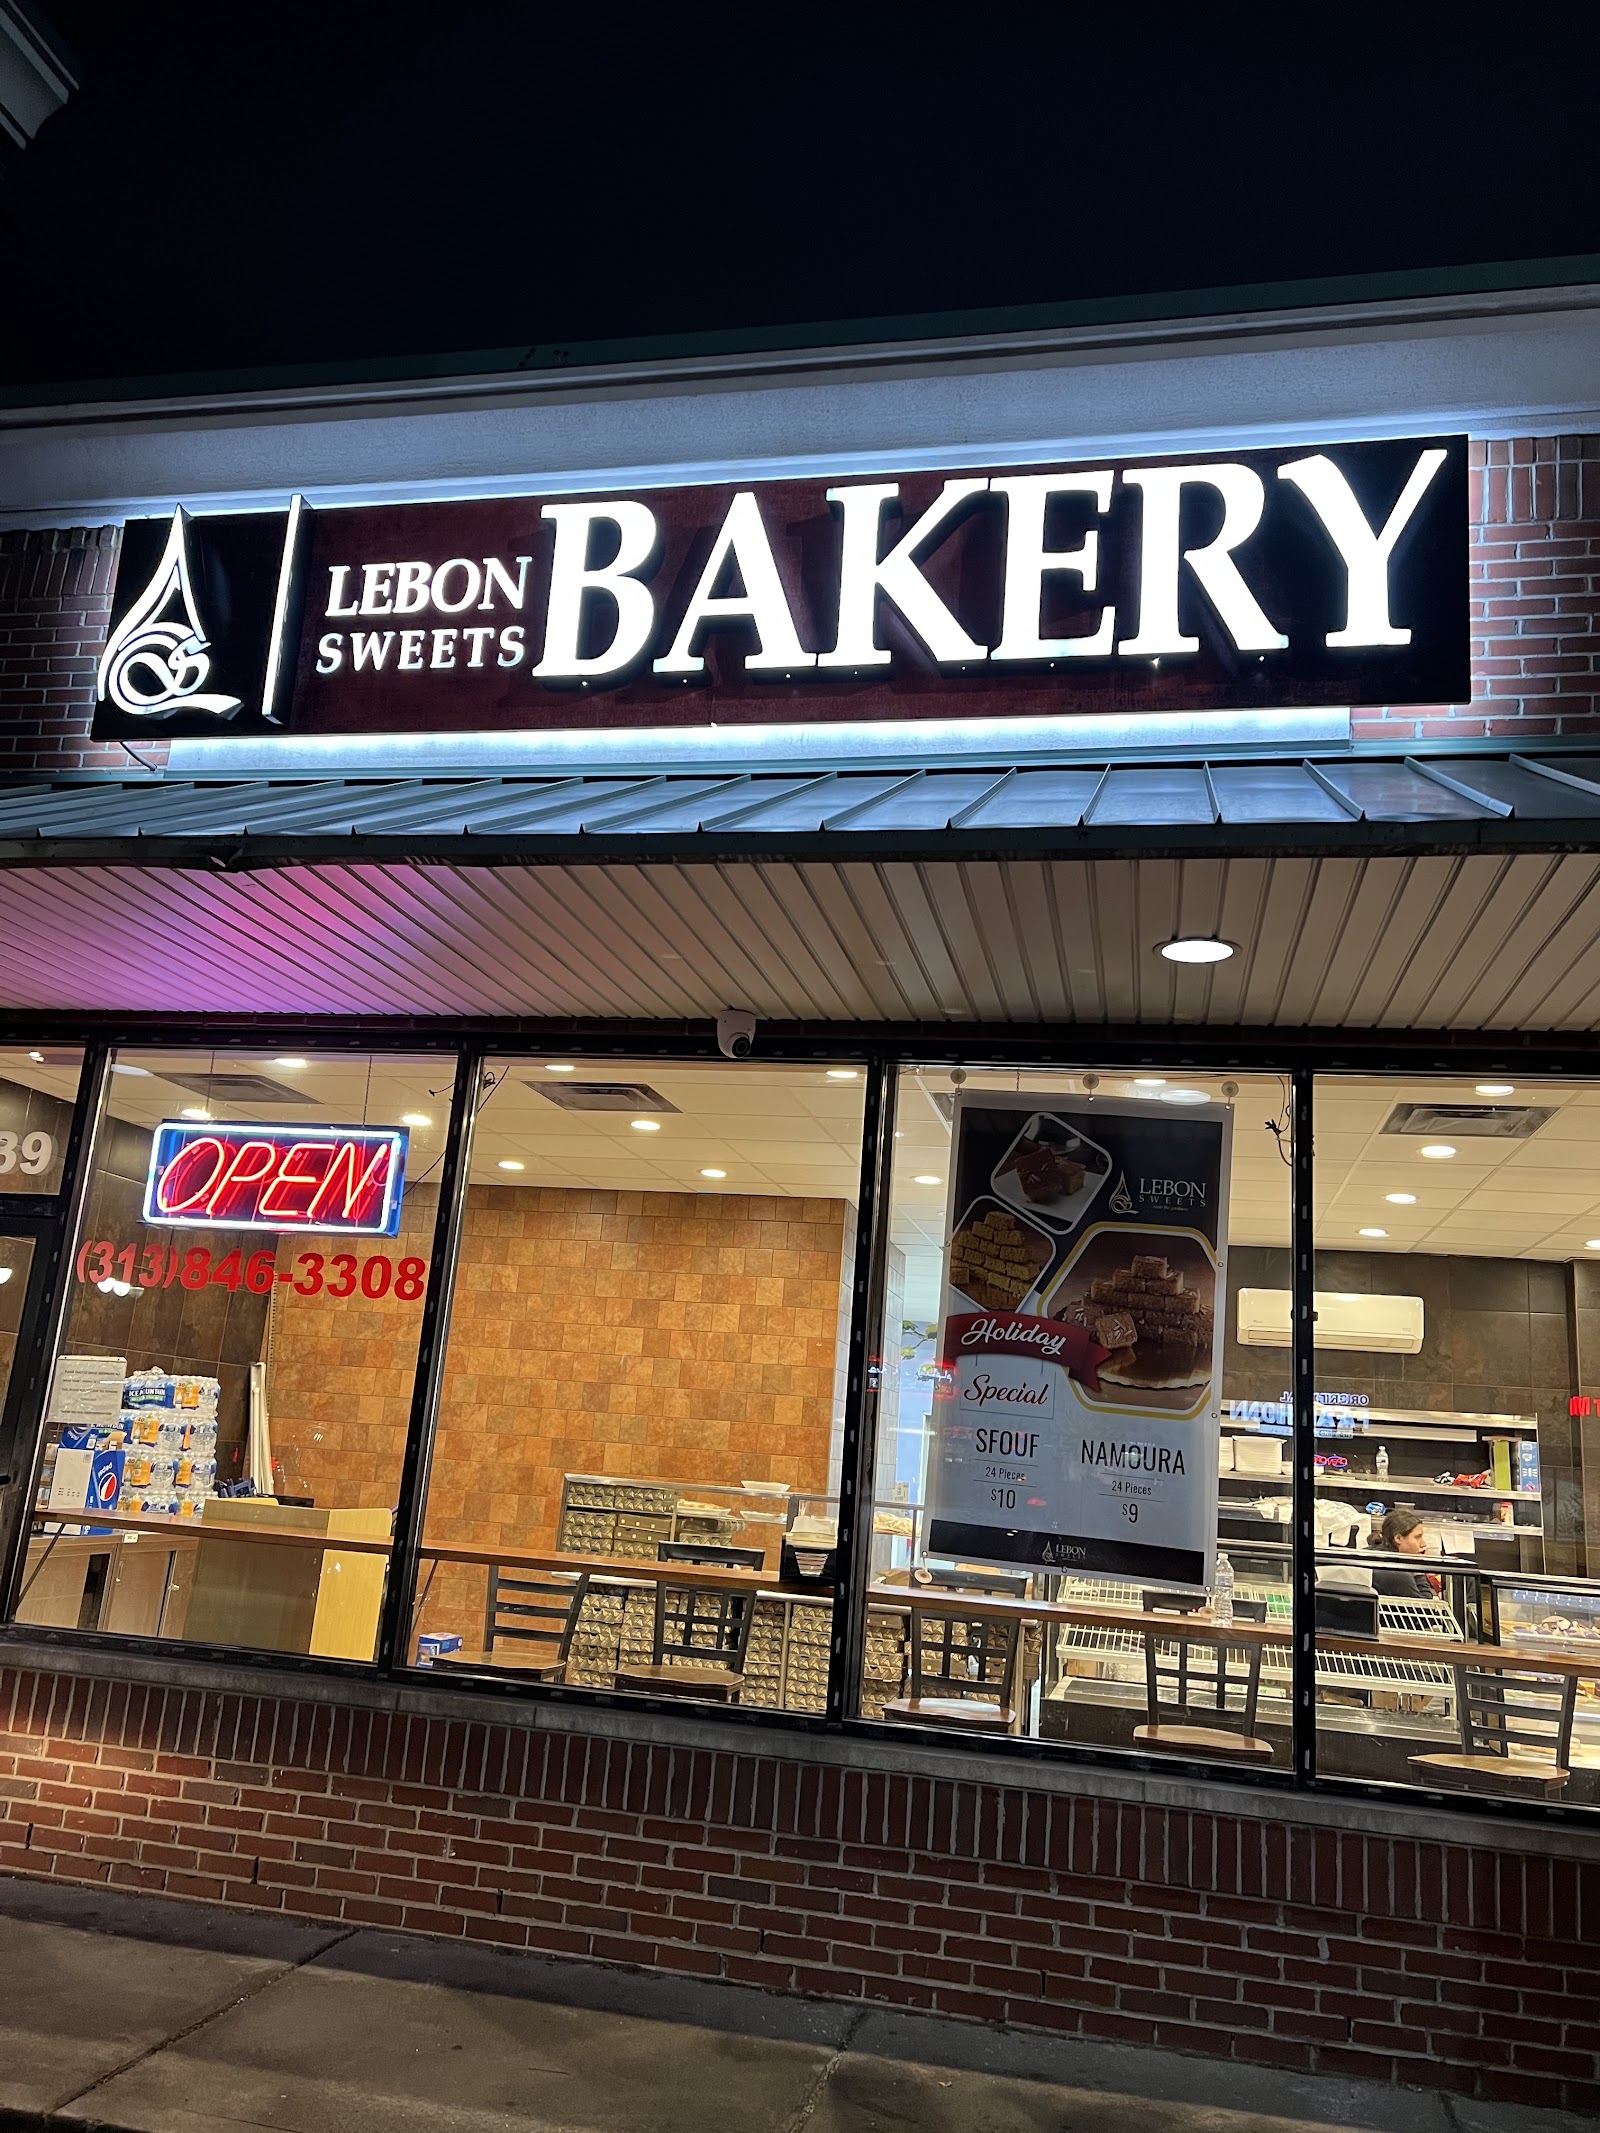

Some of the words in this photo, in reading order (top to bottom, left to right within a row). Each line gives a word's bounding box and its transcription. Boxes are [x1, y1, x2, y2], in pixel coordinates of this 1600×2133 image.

[532, 449, 1448, 678] BAKERY
[325, 556, 533, 619] LEBON
[316, 626, 526, 675] SWEETS
[157, 1137, 388, 1219] OPEN
[1139, 1178, 1207, 1198] LEBON
[1138, 1195, 1206, 1207] SWEETS
[76, 1240, 426, 1301] (313)846-3308
[960, 1318, 1068, 1356] Holiday
[963, 1374, 1050, 1407] Special
[975, 1428, 1040, 1458] SFOUF
[1081, 1439, 1186, 1476] NAMOURA
[985, 1466, 997, 1478] 24
[998, 1467, 1026, 1482] Pieces
[1111, 1481, 1123, 1492] 24
[1125, 1482, 1152, 1496] Pieces
[990, 1488, 1016, 1509] $10
[1121, 1503, 1139, 1523] $9
